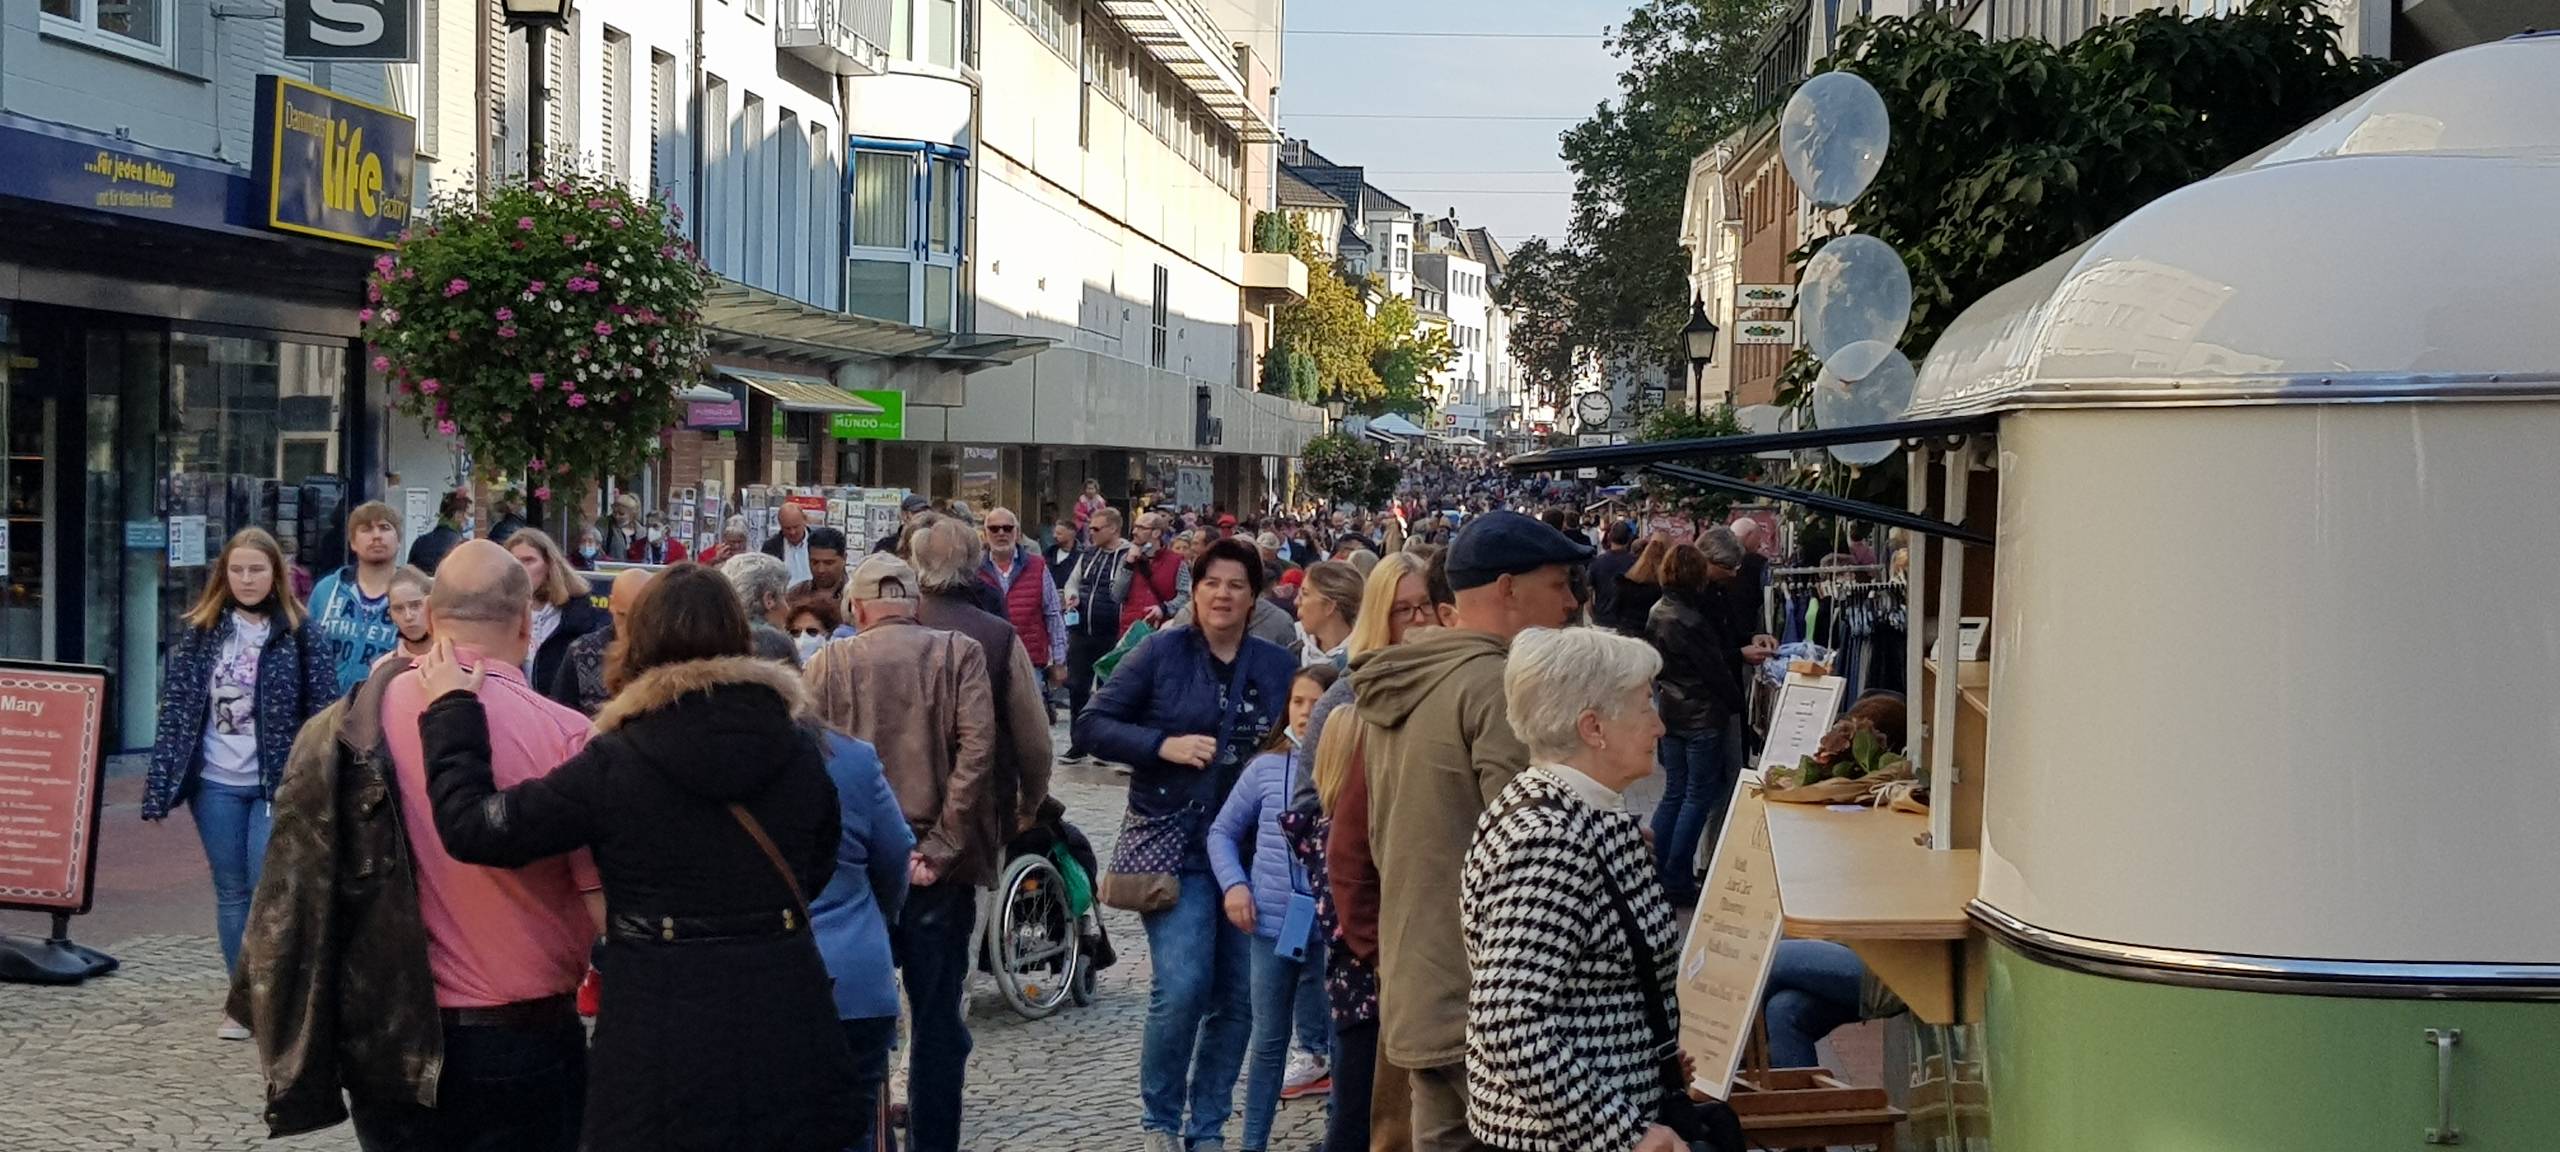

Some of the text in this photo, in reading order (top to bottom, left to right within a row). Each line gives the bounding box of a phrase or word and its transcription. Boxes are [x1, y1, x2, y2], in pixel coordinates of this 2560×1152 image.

[310, 0, 384, 46] S
[112, 153, 142, 183] jeden
[323, 118, 383, 217] life
[0, 694, 46, 717] Mary
